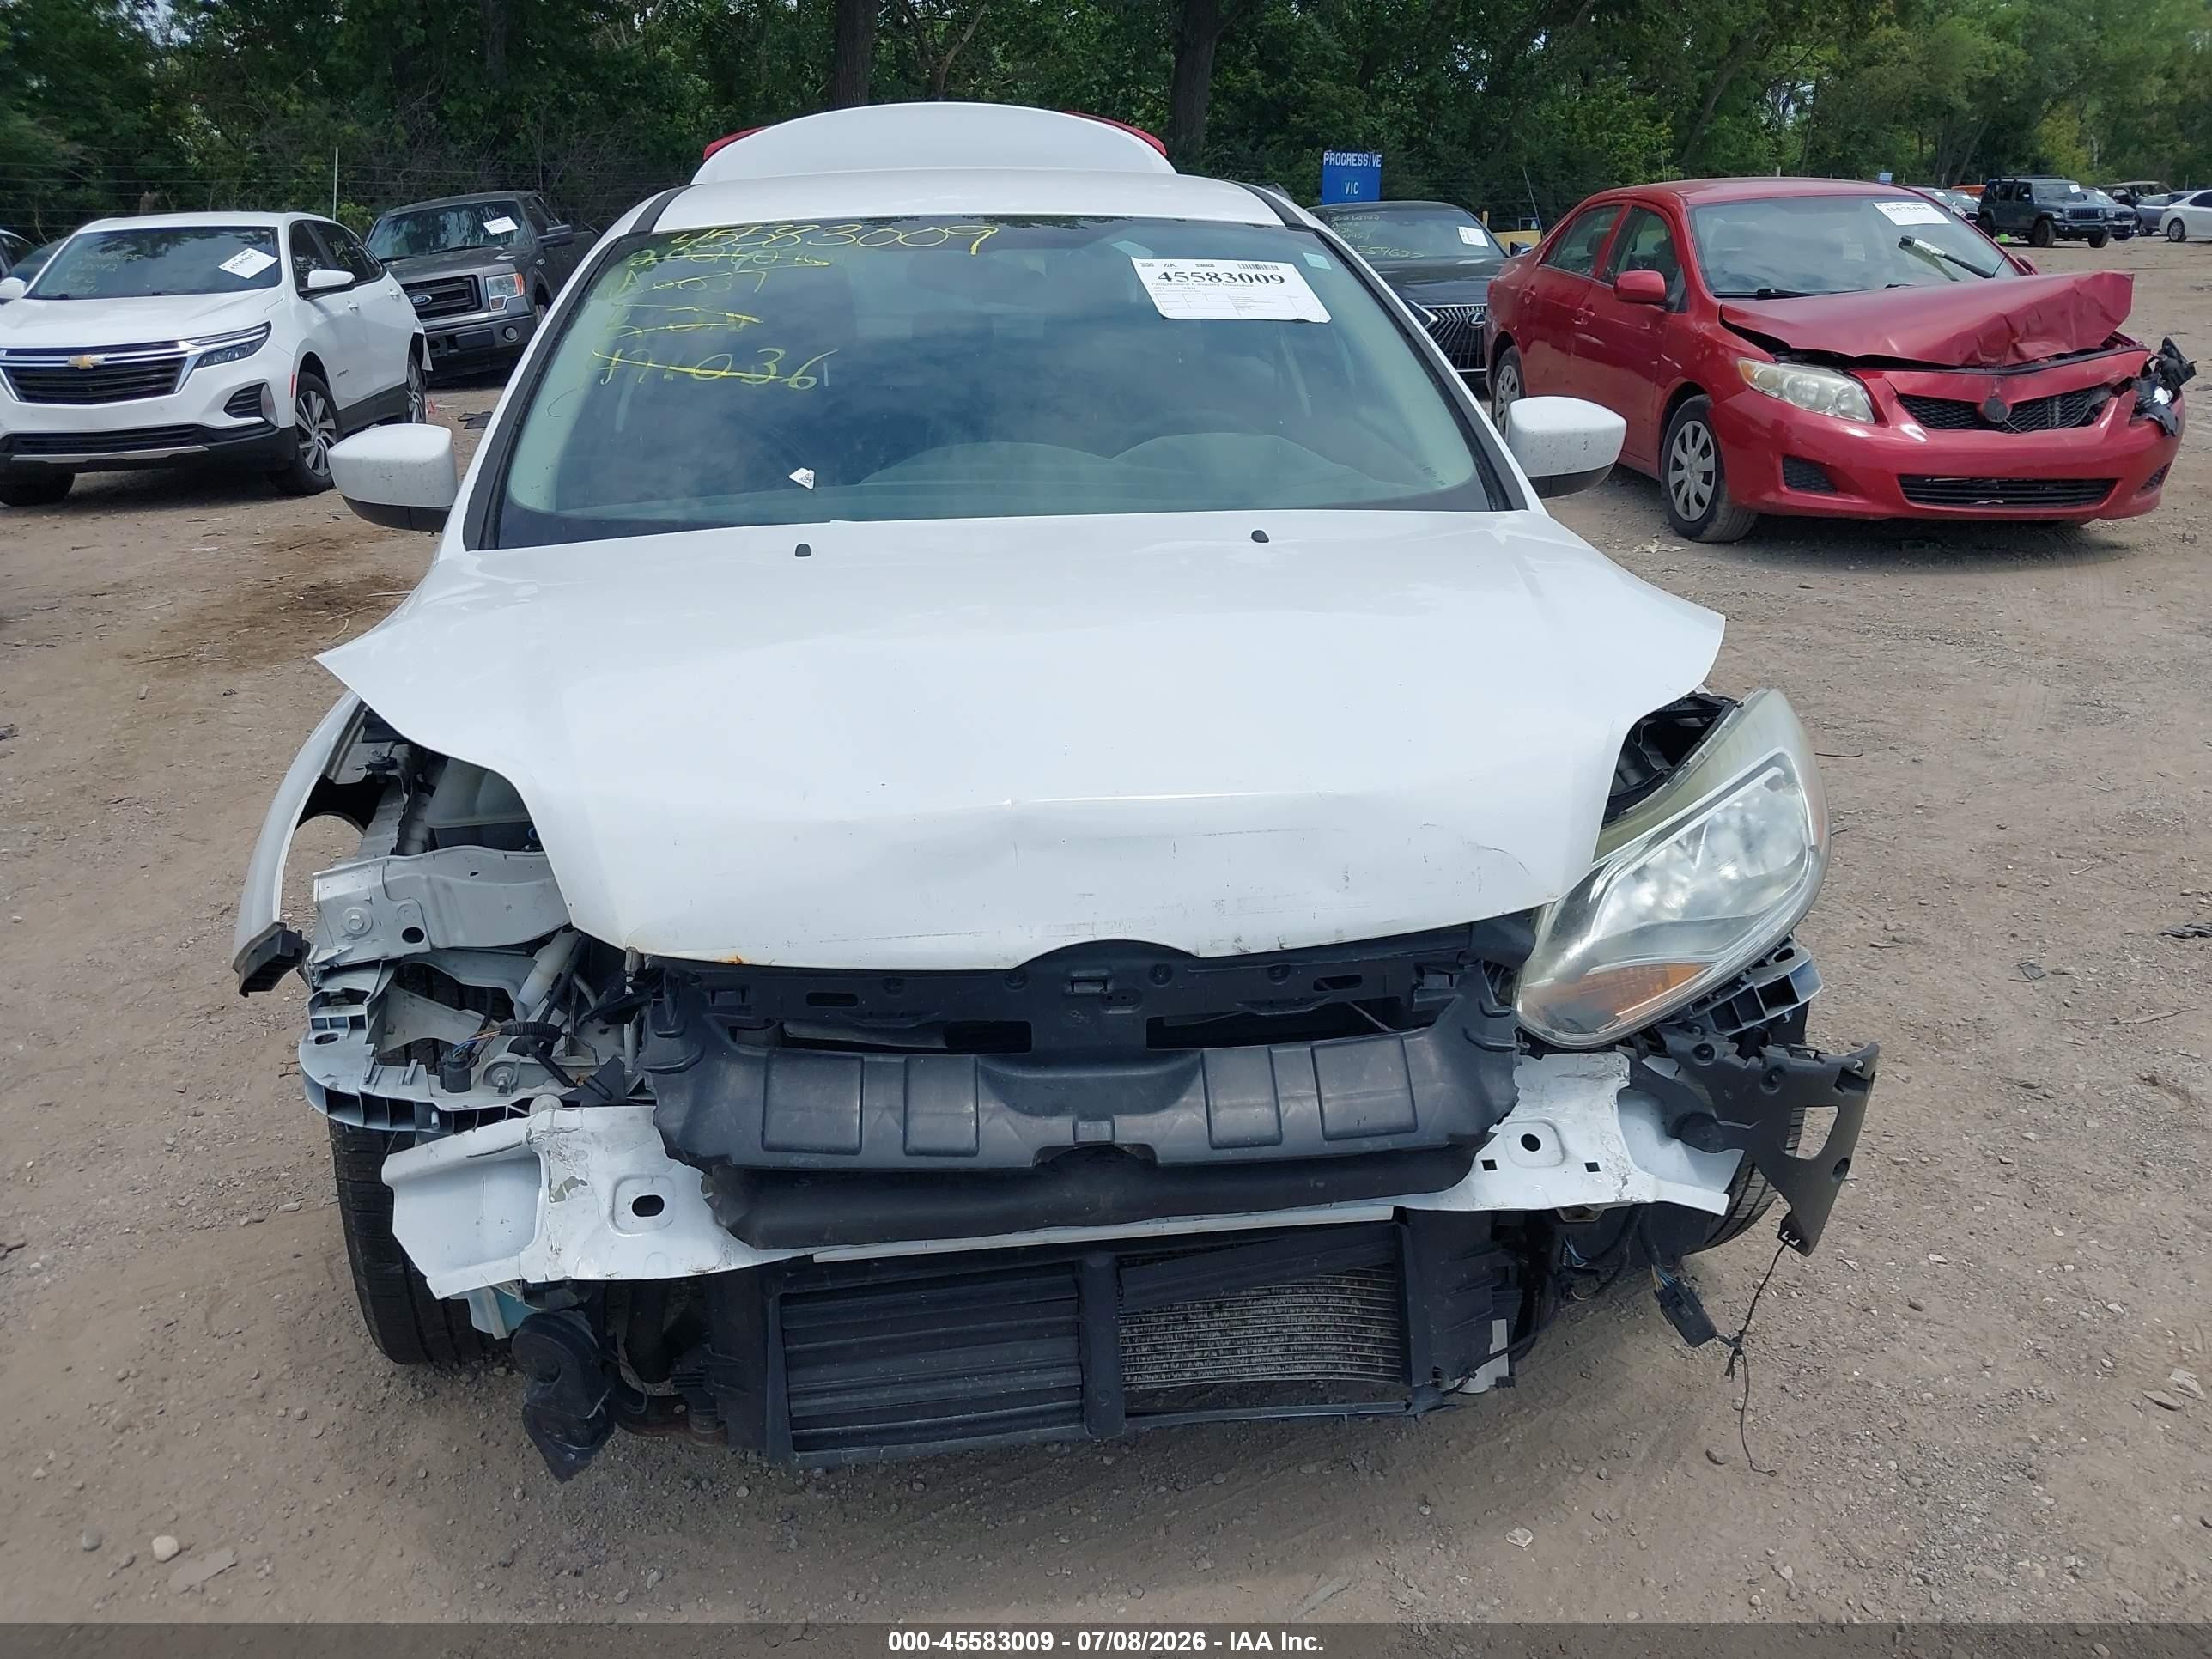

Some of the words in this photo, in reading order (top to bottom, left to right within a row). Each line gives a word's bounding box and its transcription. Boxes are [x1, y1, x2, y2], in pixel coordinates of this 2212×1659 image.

[1323, 152, 1382, 167] PROGRESSIVE
[1345, 181, 1359, 195] VIC
[671, 223, 999, 255] 45583009
[1158, 271, 1285, 285] 45583009
